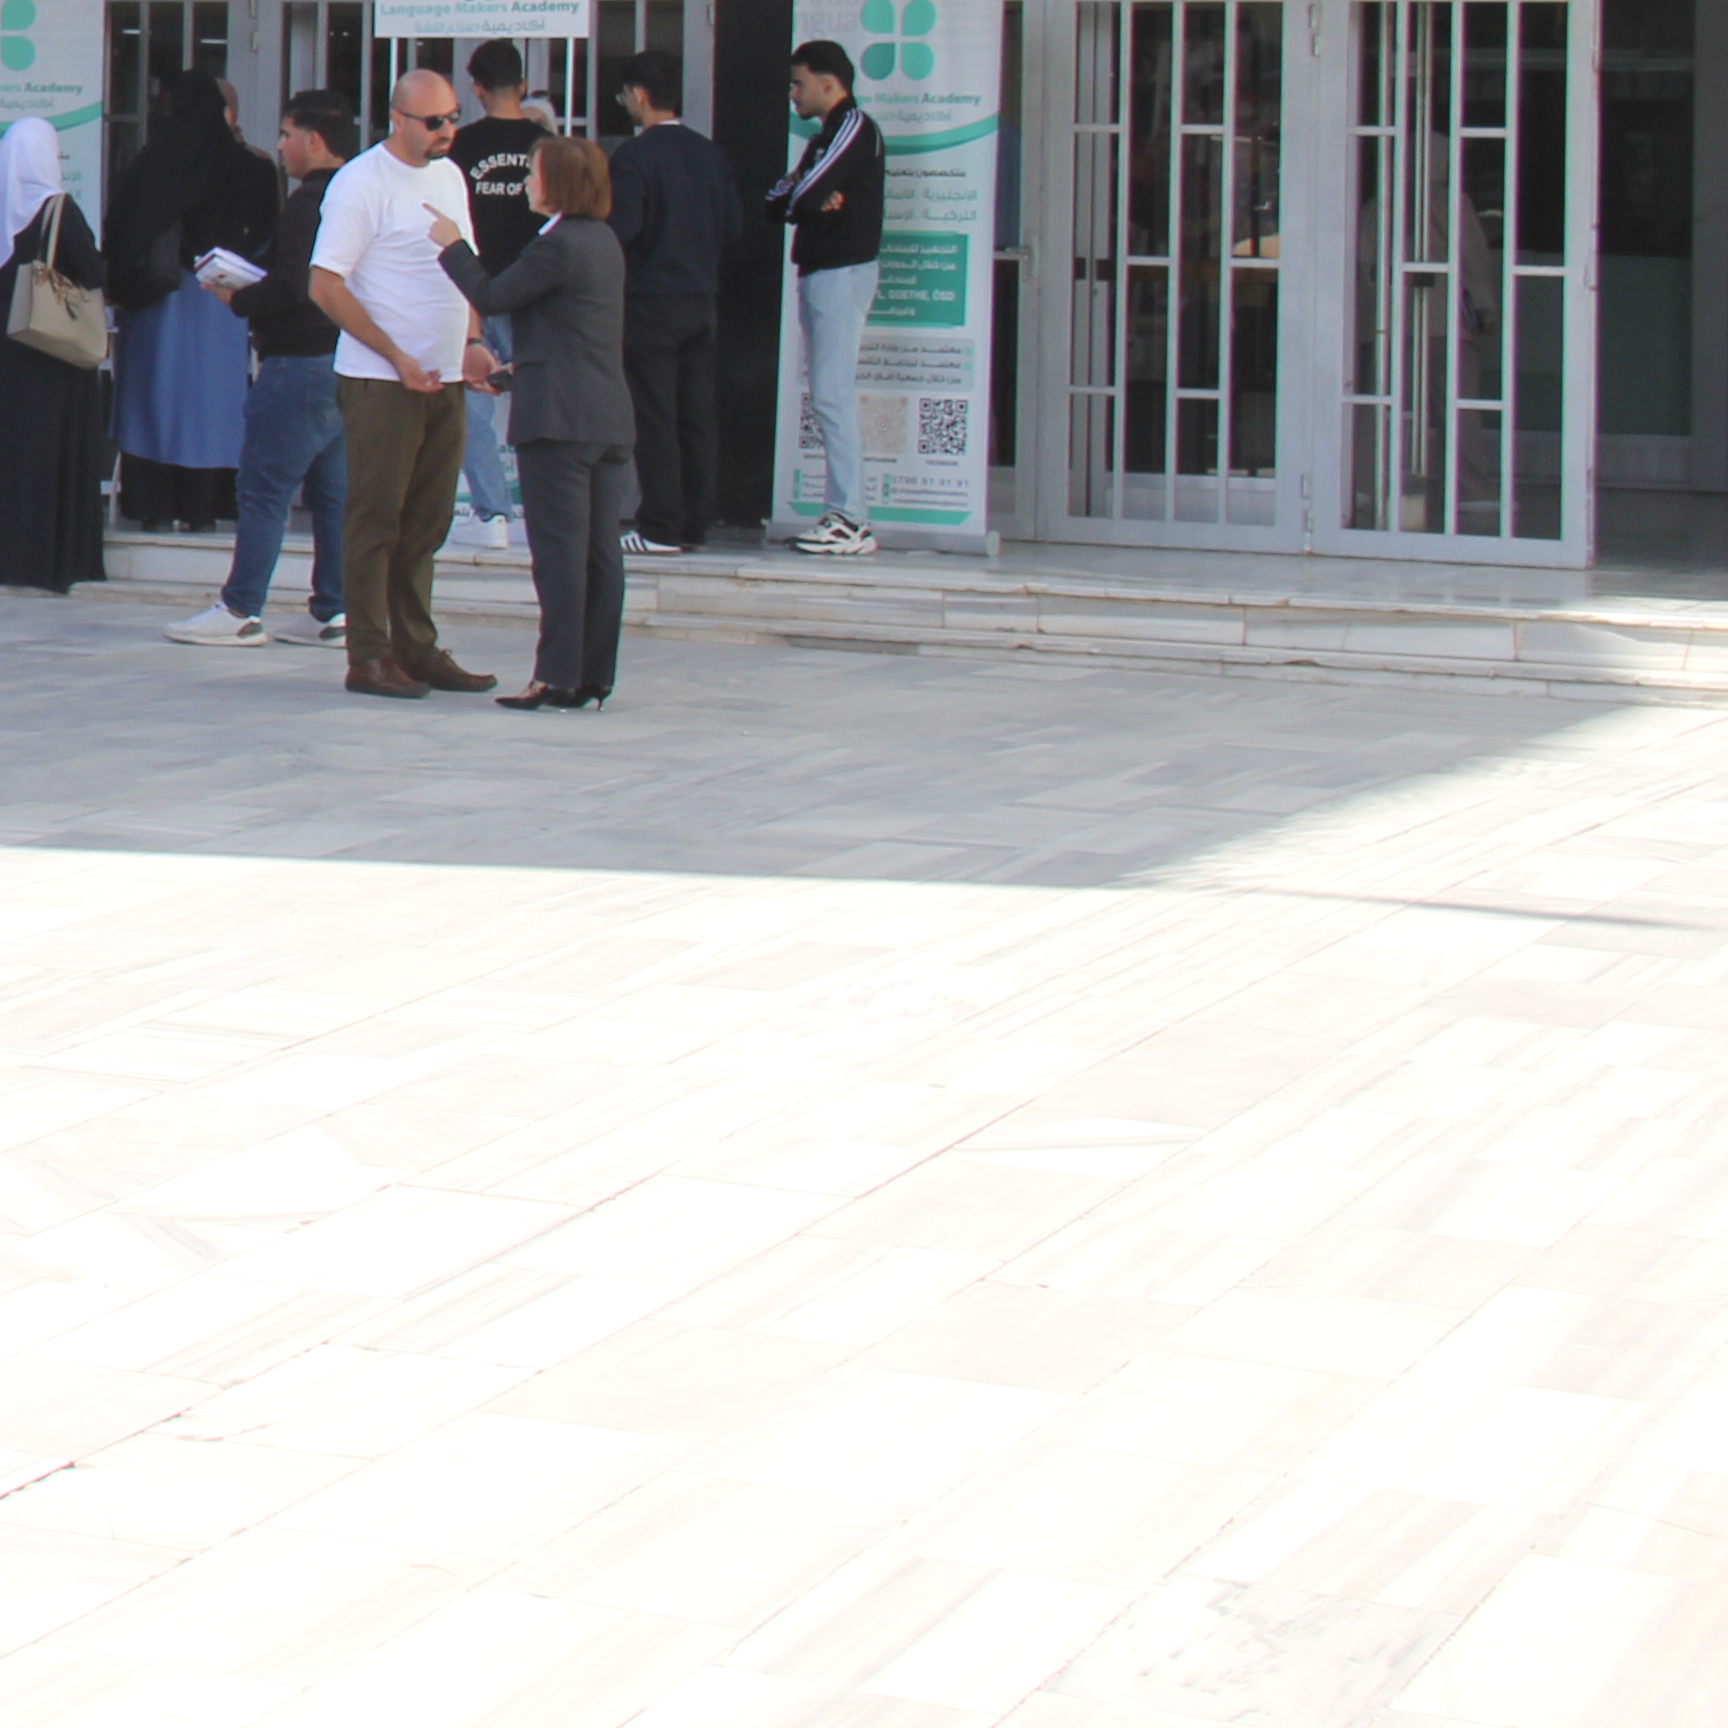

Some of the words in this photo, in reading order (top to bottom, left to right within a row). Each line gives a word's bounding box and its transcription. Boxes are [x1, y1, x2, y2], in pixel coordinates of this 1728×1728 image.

[380, 4, 452, 18] Language
[455, 2, 508, 14] Makers
[511, 0, 579, 14] Academy
[24, 83, 83, 95] Academy
[875, 93, 919, 104] Makers
[921, 93, 981, 105] Academy
[475, 181, 505, 196] FEAR
[506, 182, 523, 196] OF
